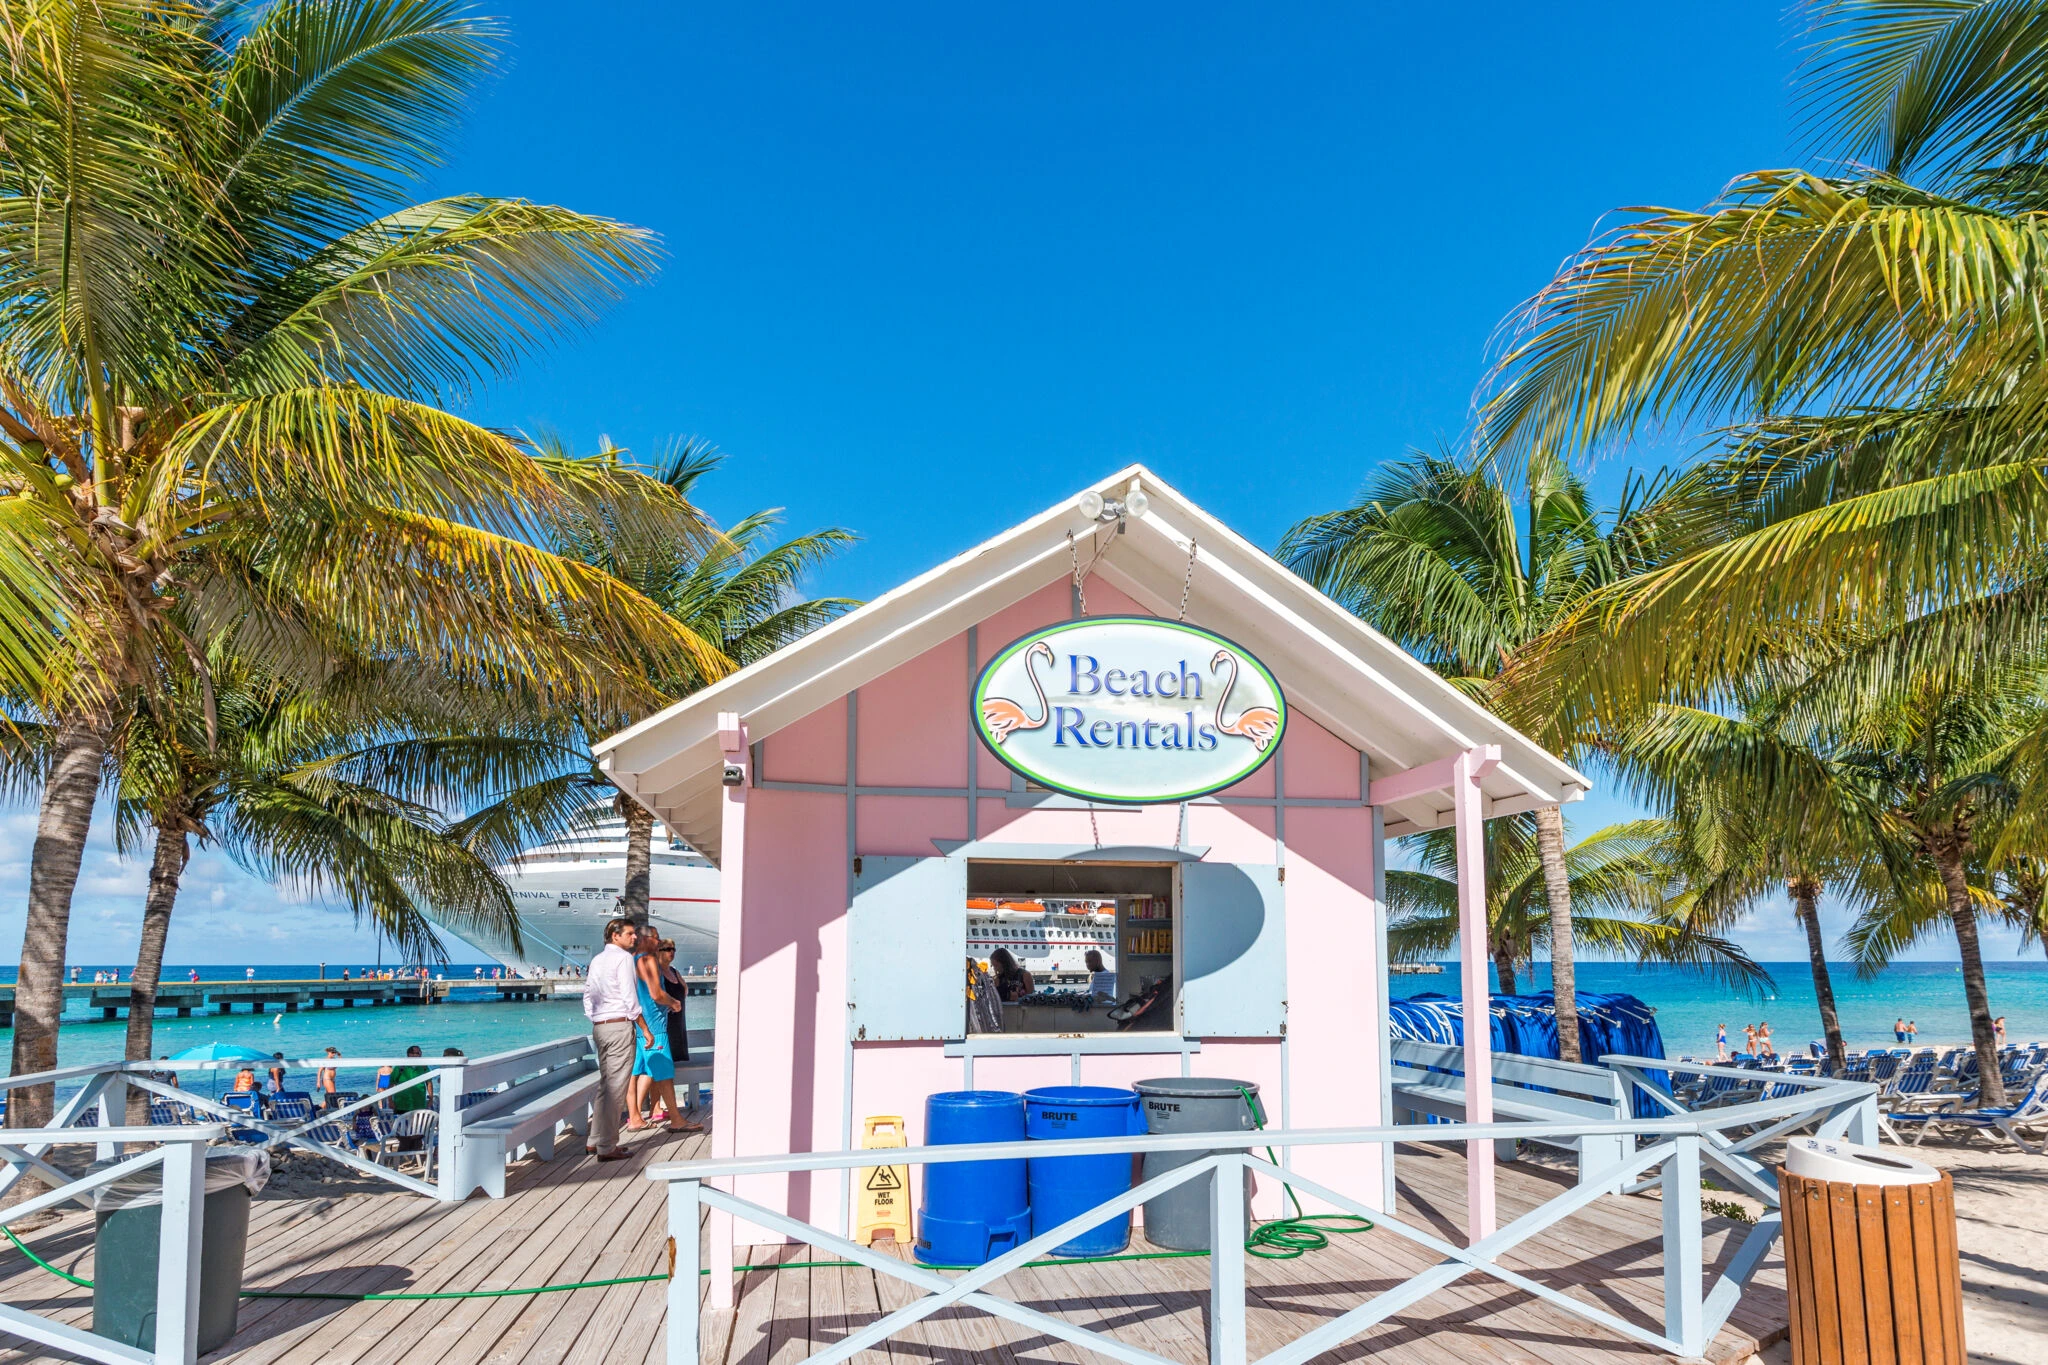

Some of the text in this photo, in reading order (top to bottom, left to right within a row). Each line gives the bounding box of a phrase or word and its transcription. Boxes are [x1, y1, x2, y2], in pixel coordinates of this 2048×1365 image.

[1067, 654, 1204, 699] Beach
[1051, 705, 1218, 750] Rentals
[510, 891, 611, 900] RNIVAL BREEZE
[1147, 1101, 1181, 1112] BRUTE
[1041, 1111, 1078, 1121] BRUTE
[874, 1198, 894, 1206] FLOOR
